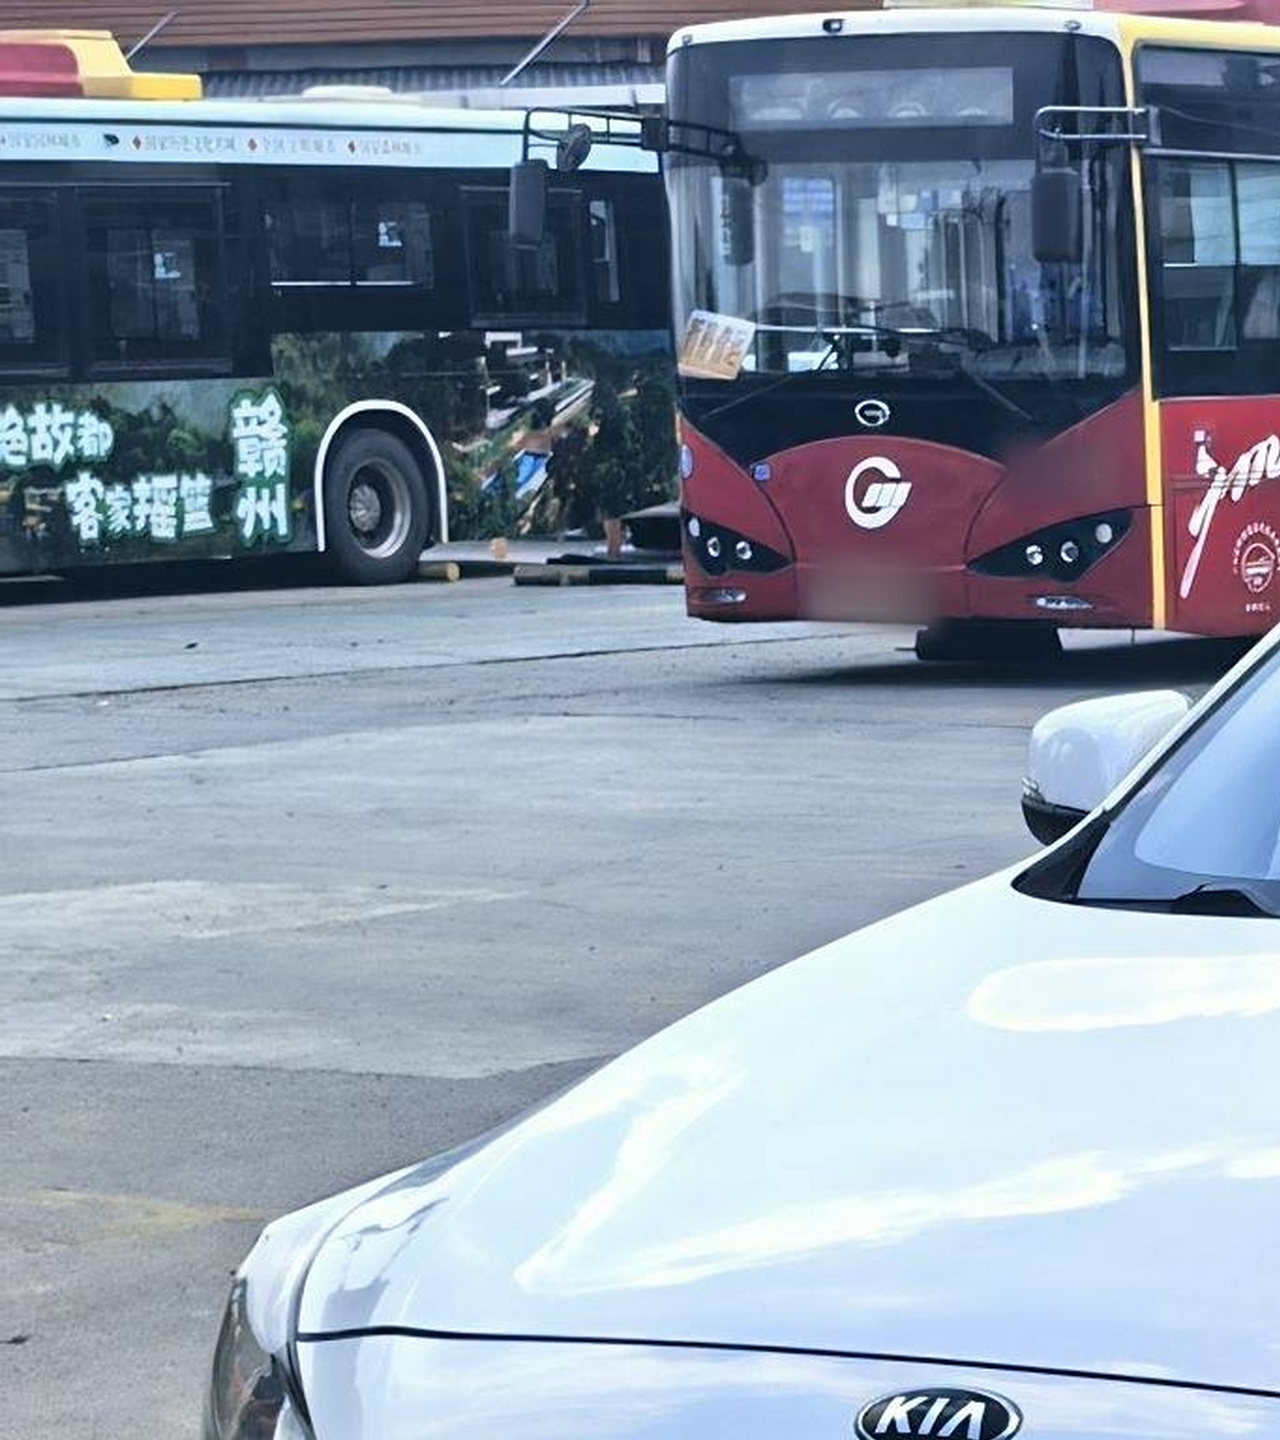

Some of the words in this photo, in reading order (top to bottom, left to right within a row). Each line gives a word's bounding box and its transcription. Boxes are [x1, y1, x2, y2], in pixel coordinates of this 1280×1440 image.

[232, 393, 288, 538] 赣州
[64, 470, 214, 541] 客家摇篮
[874, 1396, 985, 1440] KIA
